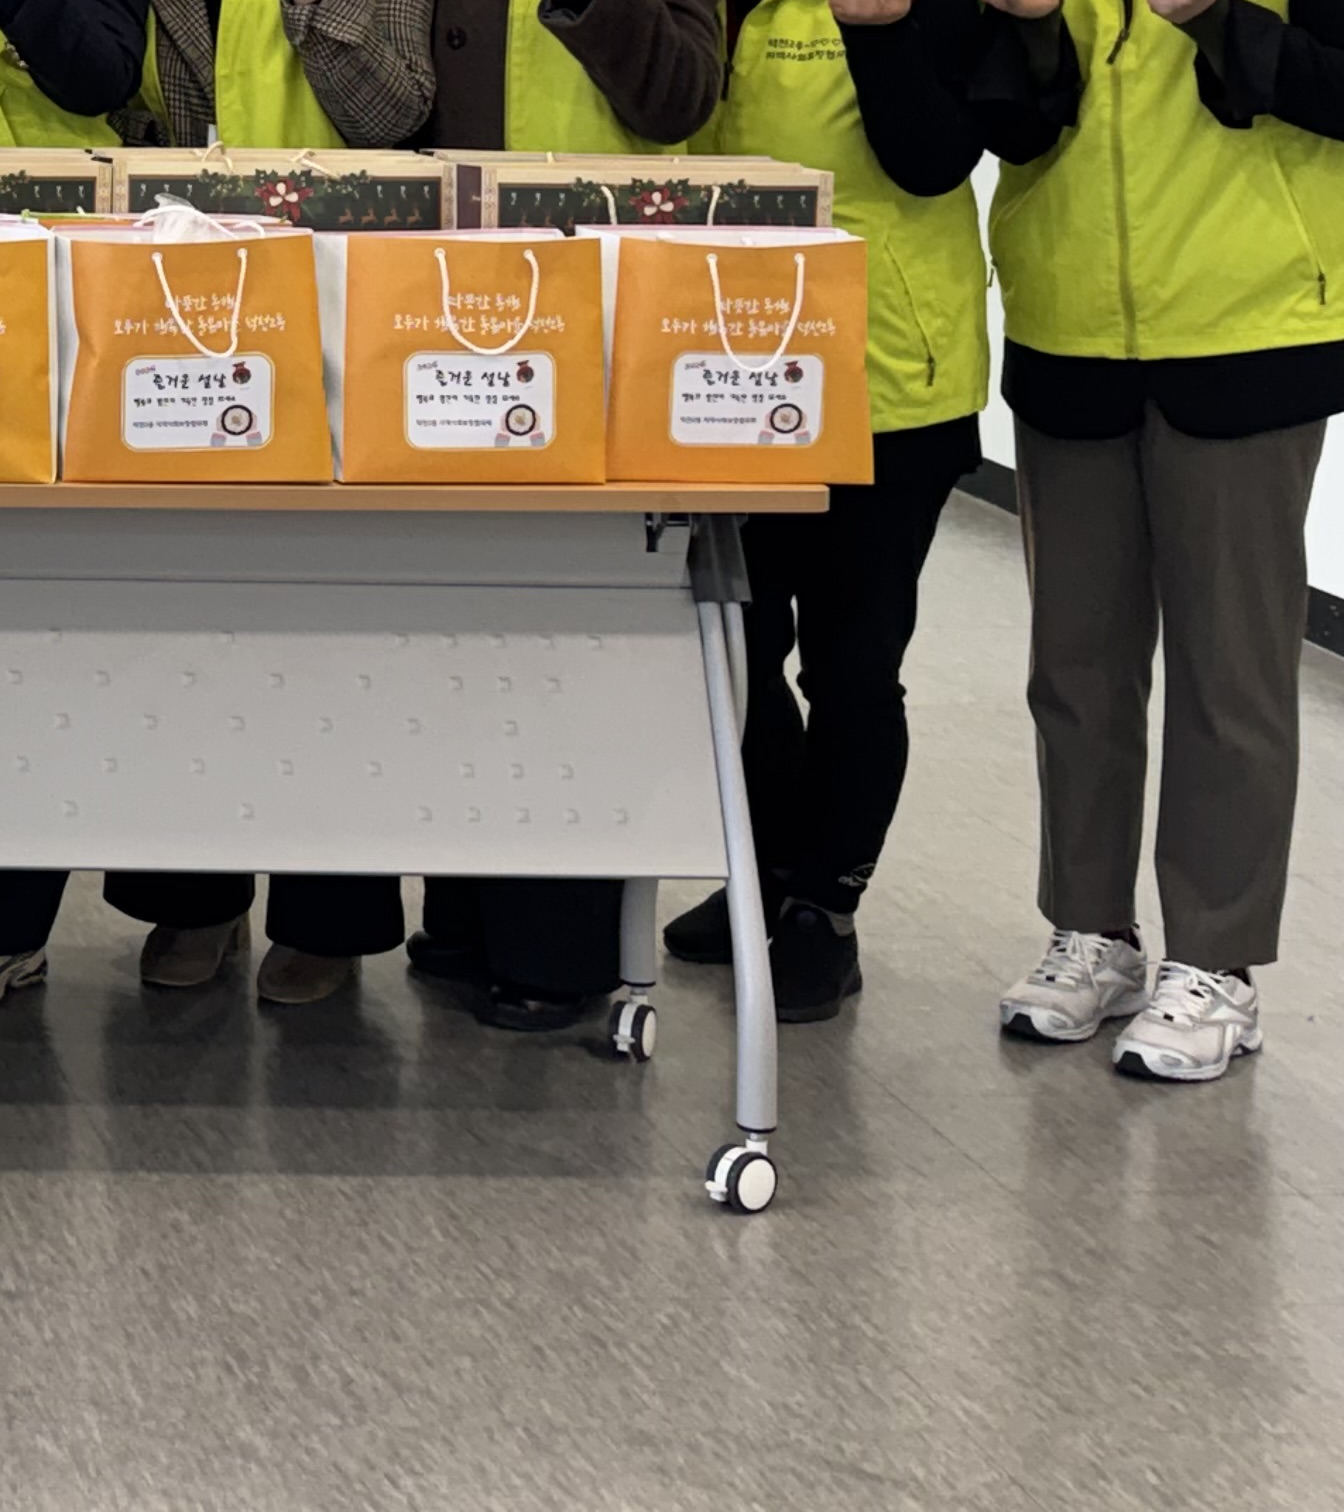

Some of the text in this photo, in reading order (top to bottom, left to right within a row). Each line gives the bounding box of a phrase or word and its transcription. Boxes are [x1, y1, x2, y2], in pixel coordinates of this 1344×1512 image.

[153, 373, 226, 389] 즐거운 설날
[435, 370, 510, 387] 즐거운 설날
[703, 369, 778, 386] 즐거운 설날
